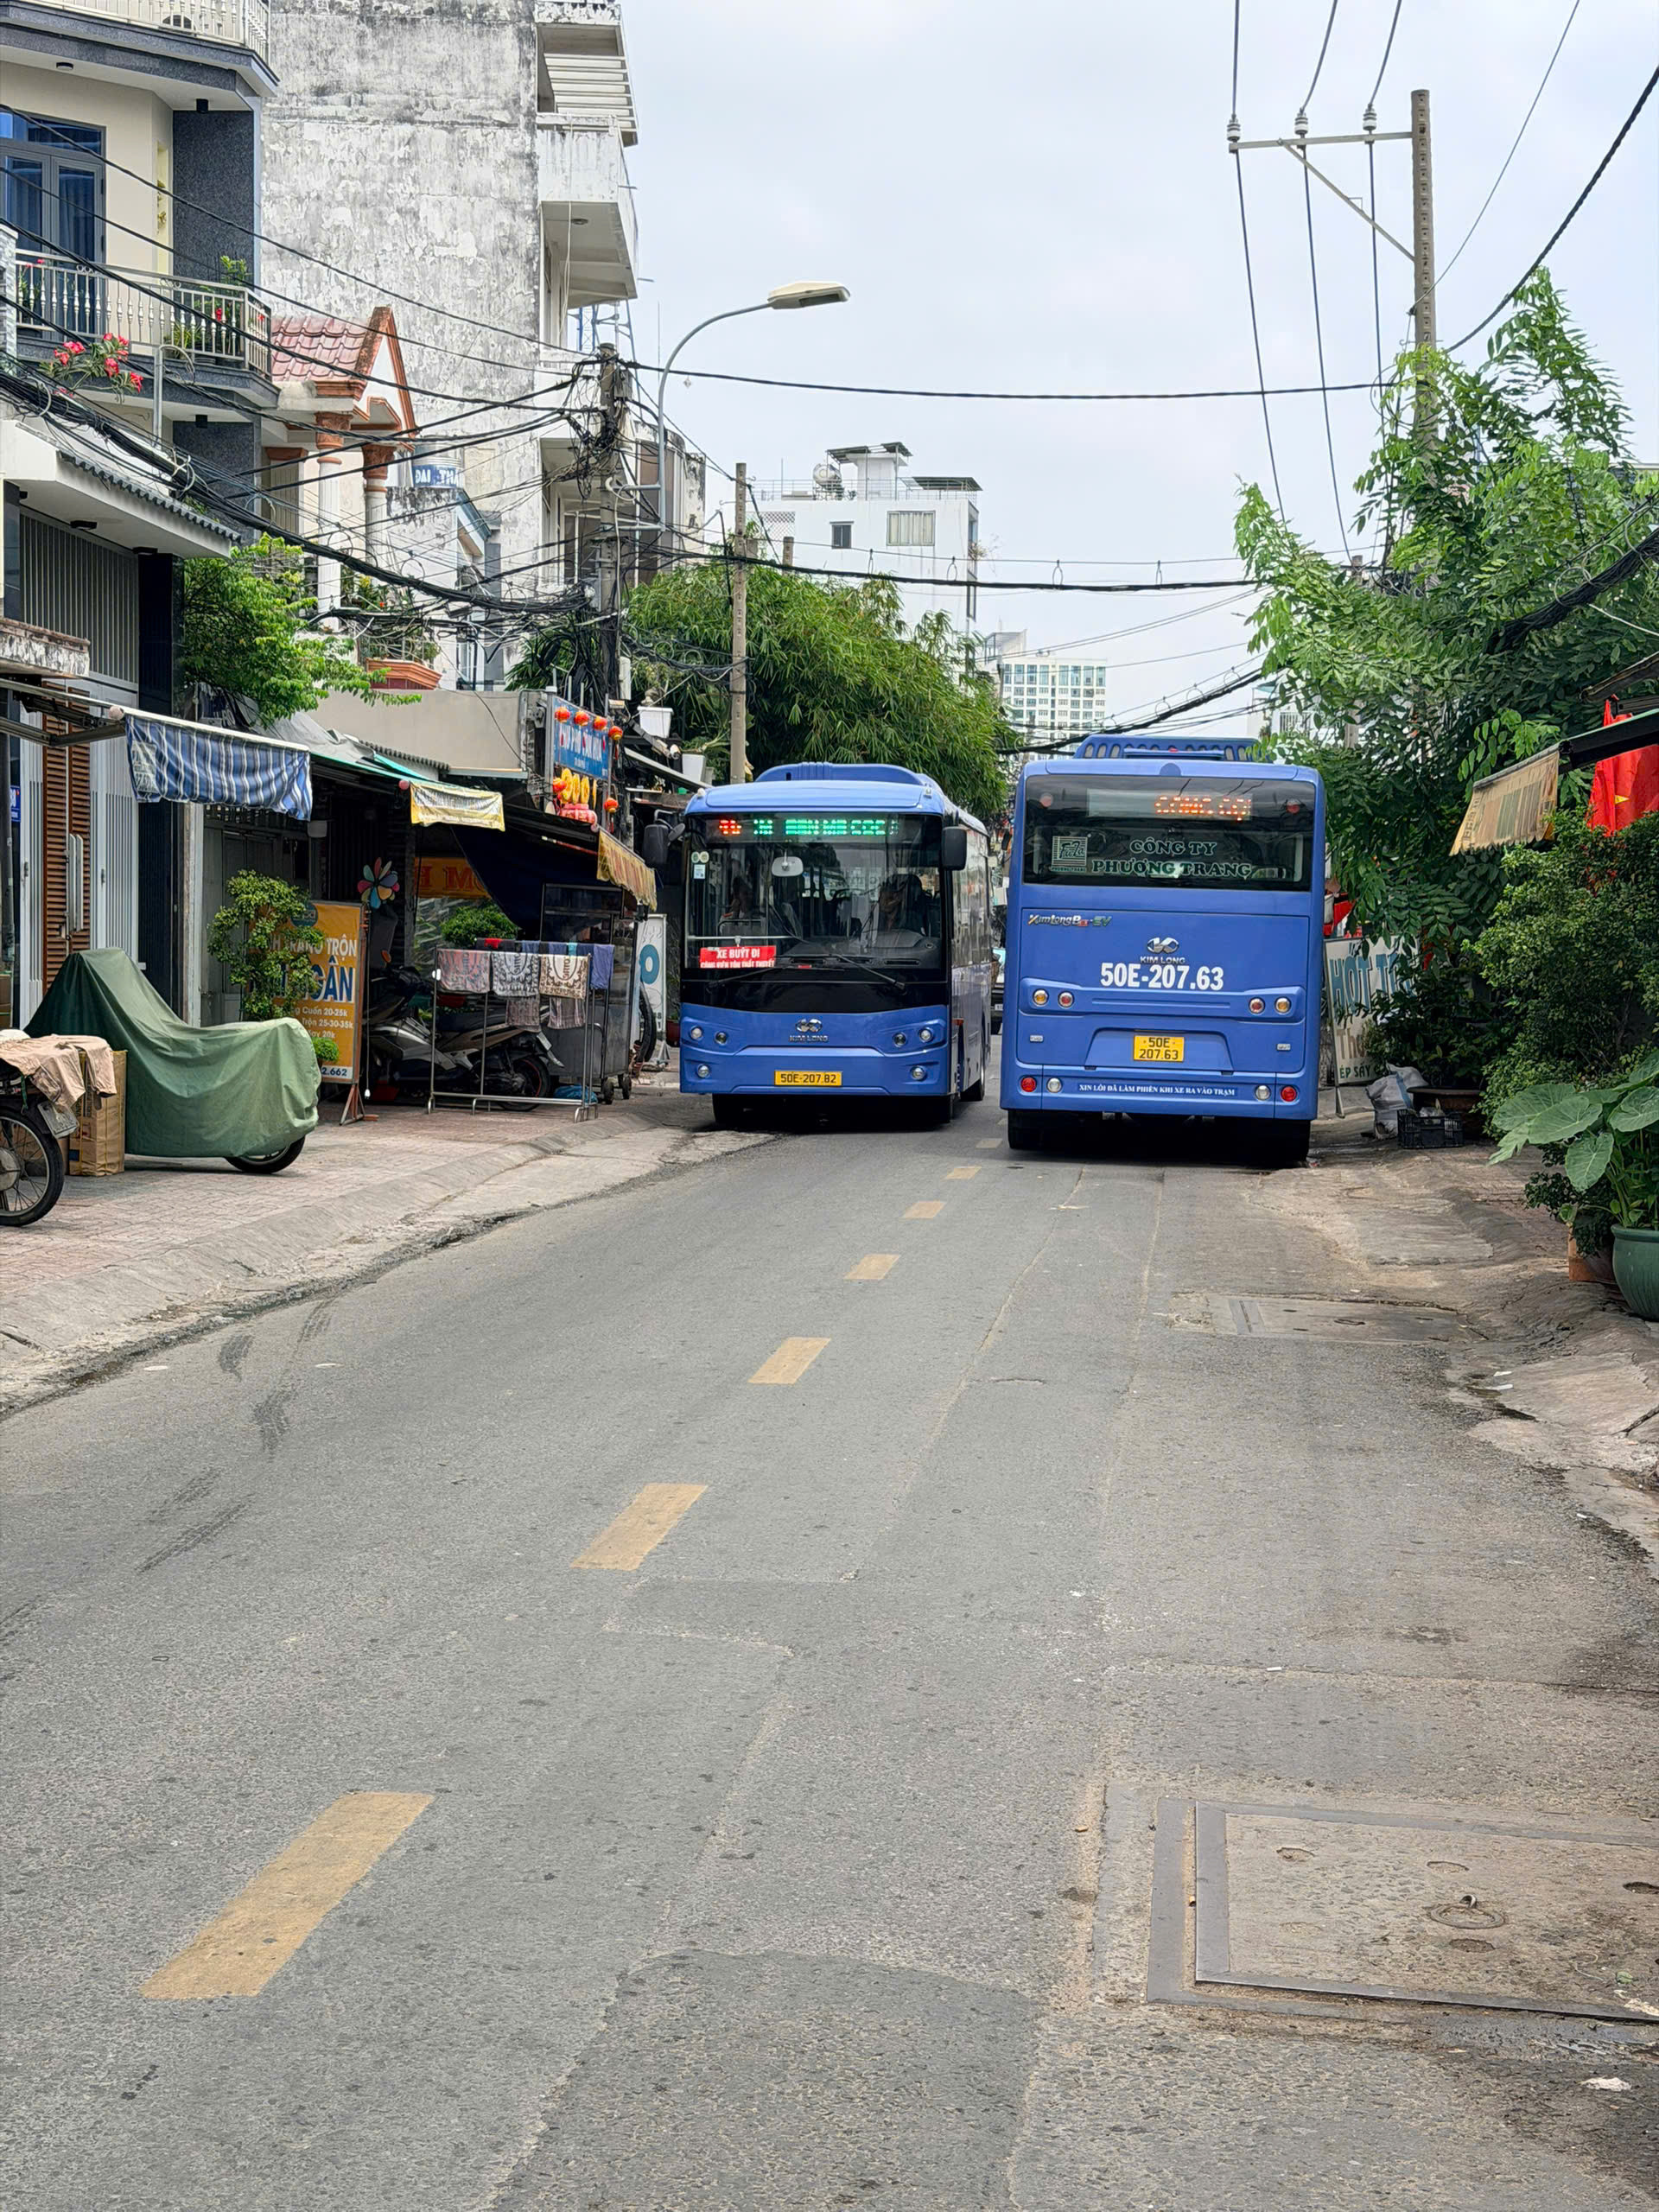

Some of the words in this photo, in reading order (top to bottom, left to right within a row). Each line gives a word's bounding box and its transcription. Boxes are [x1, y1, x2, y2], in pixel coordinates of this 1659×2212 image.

[1129, 836, 1186, 856] CÔNG
[1188, 842, 1217, 856] TY
[1091, 857, 1178, 877] PHƯƠNG
[1179, 861, 1253, 880] TRANG
[326, 933, 357, 960] TRỘN
[716, 949, 728, 959] XE
[729, 946, 751, 959] BUÝT
[1140, 956, 1159, 964] KIM
[1160, 956, 1185, 965] LONG
[1100, 962, 1224, 991] 50E-207.63
[302, 1005, 322, 1016] Cuốn
[323, 1007, 348, 1017] 20-25k
[1148, 1036, 1170, 1048] 50E
[1138, 1048, 1179, 1061] 207.63
[780, 1073, 837, 1084] 50E-207.82
